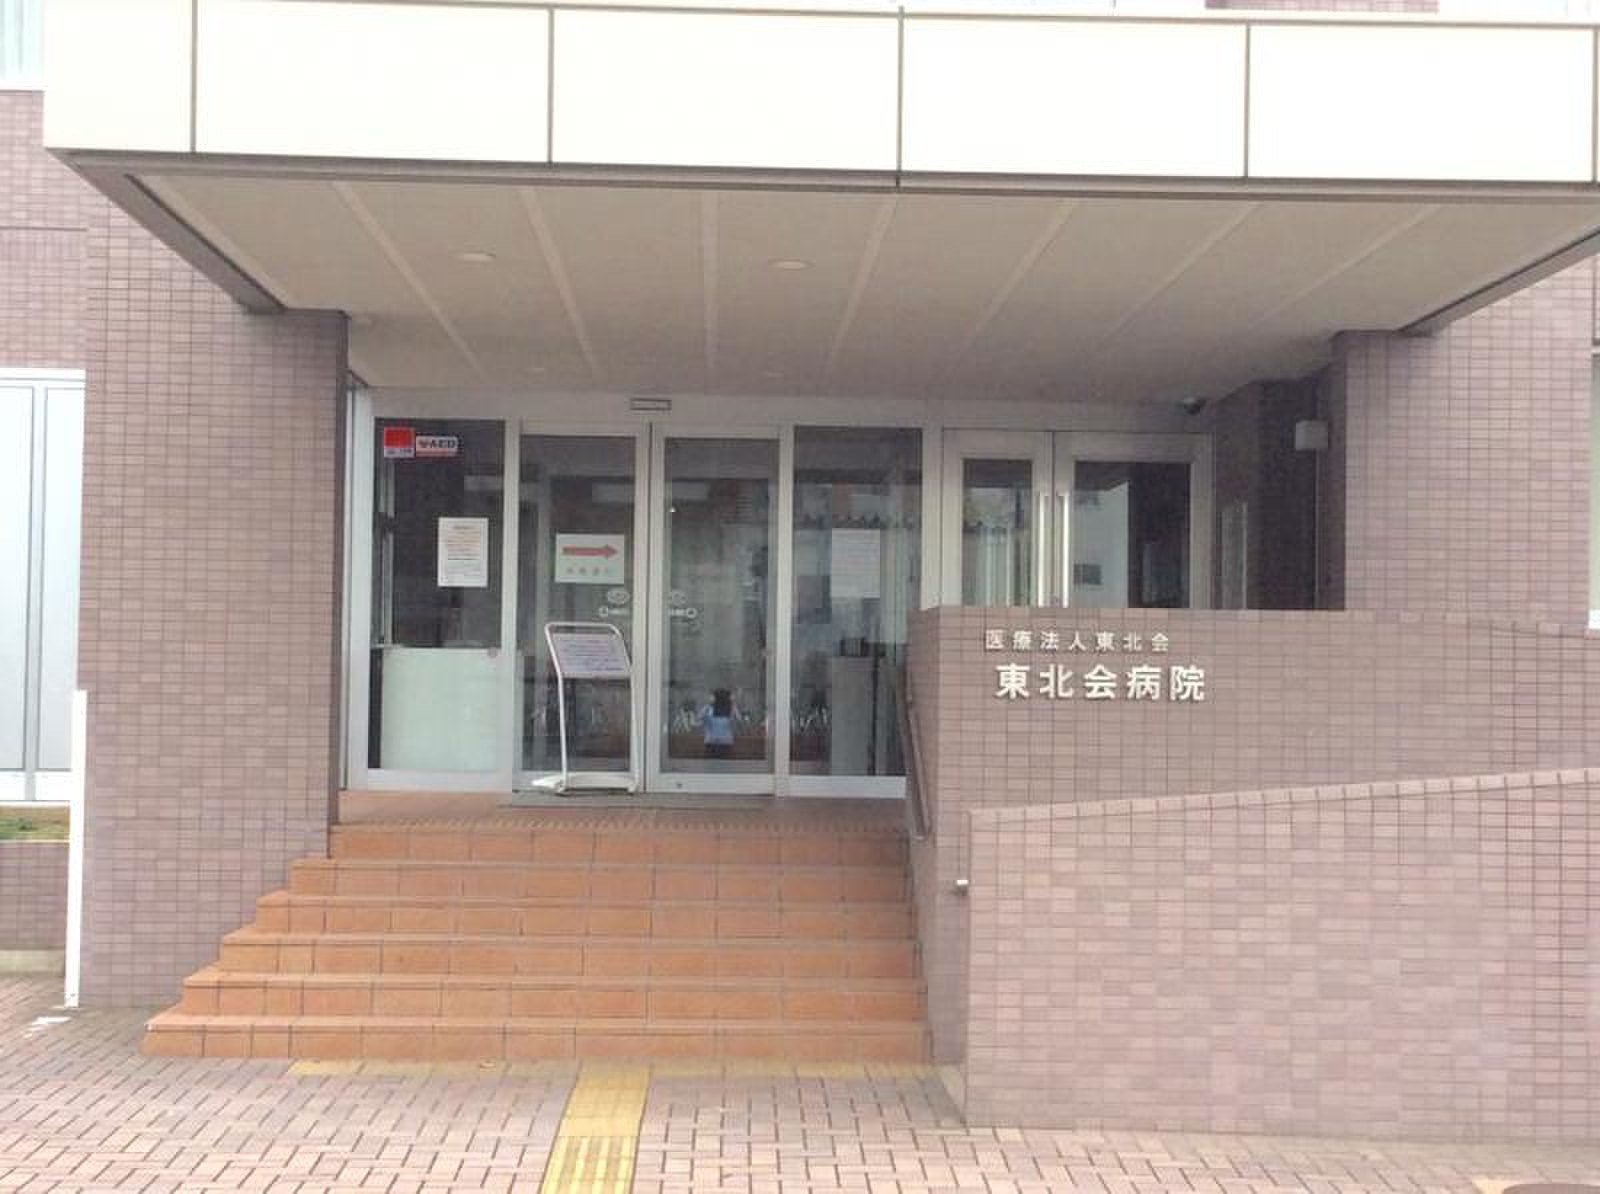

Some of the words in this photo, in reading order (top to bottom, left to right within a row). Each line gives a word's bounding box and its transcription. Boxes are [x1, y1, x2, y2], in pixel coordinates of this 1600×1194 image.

[985, 629, 1169, 652] 医療法人東北会
[995, 662, 1206, 701] 東北会病院
